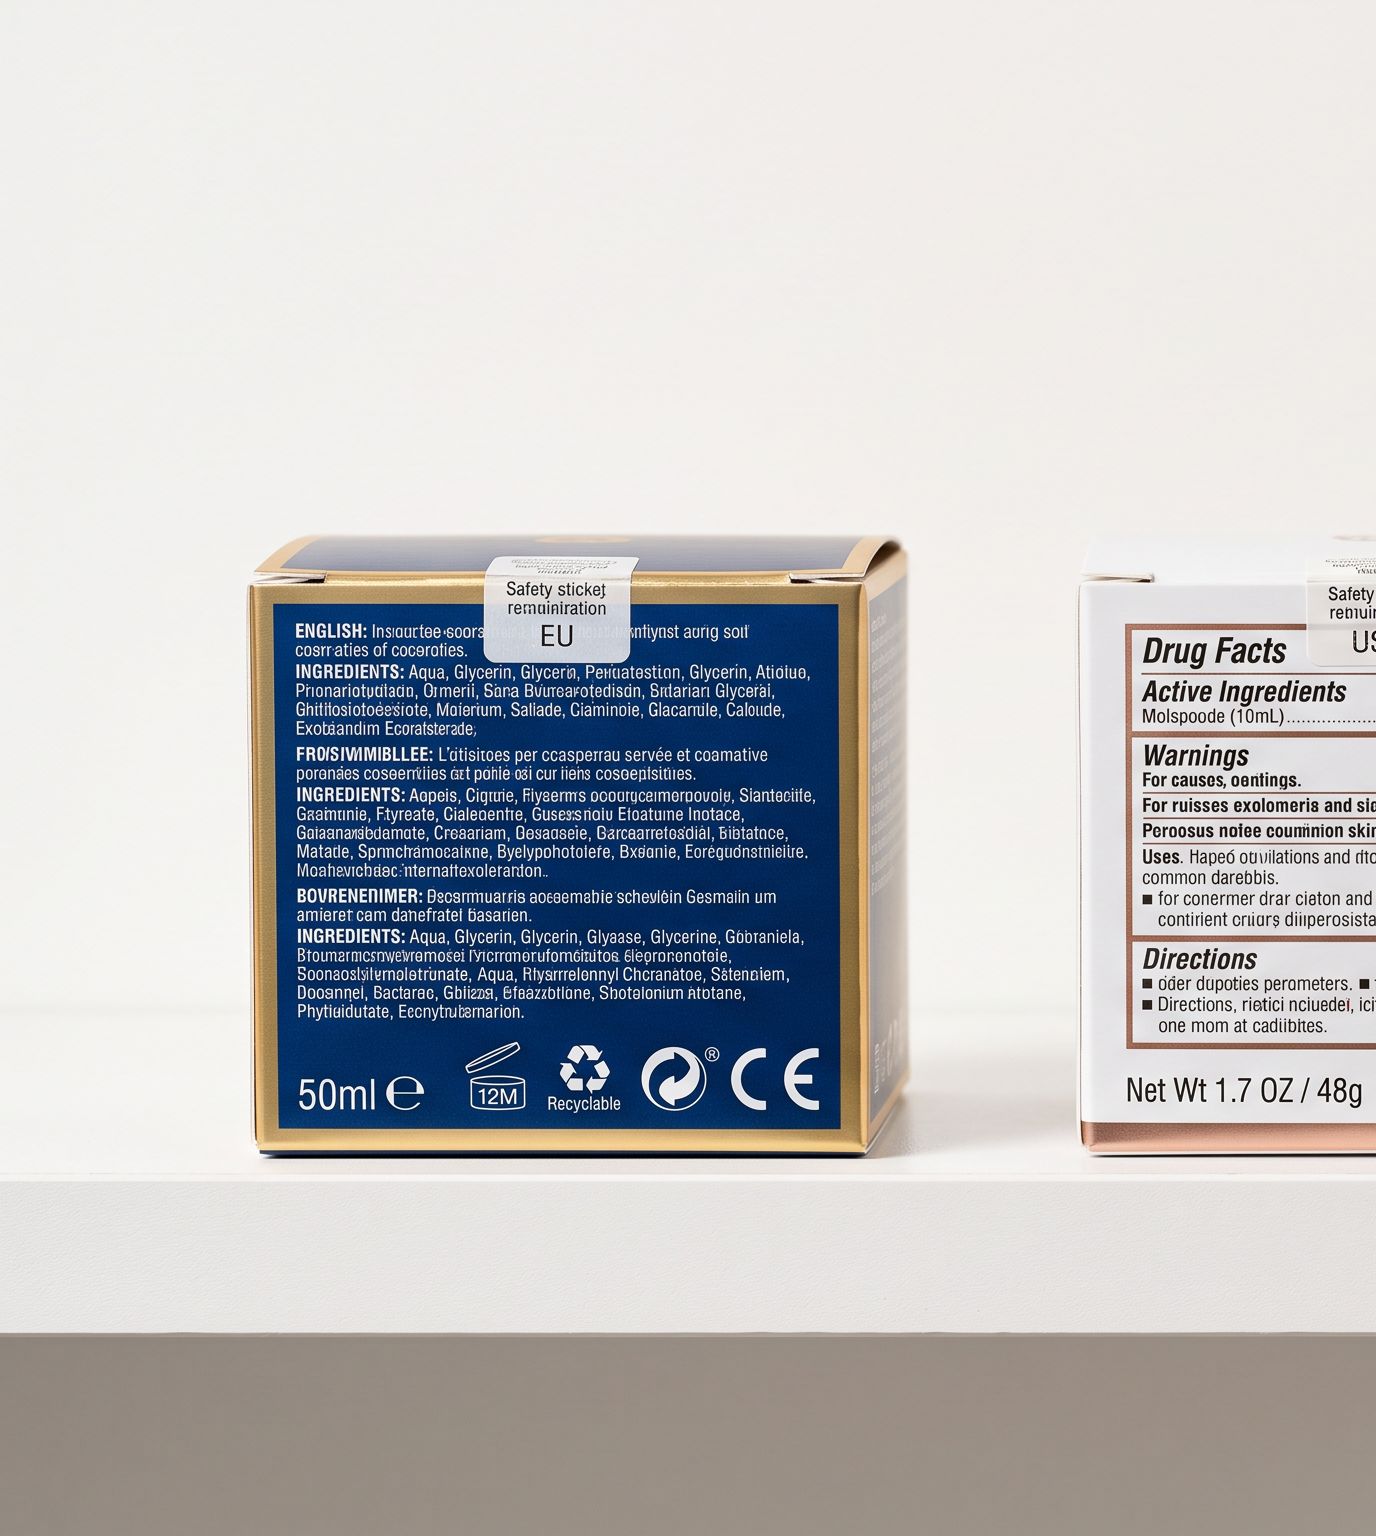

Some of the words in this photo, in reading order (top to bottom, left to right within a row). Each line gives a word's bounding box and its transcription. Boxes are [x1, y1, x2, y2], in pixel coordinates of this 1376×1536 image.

[506, 580, 553, 600] Safety
[1328, 586, 1375, 605] Safety
[295, 622, 368, 639] ENGLISH:
[541, 624, 573, 648] EU
[373, 641, 389, 658] of
[1142, 637, 1208, 670] Drug
[1214, 636, 1287, 664] Facts
[295, 663, 405, 680] INGREDIENTS:
[408, 663, 449, 682] Aqua,
[454, 663, 516, 683] Glycerin,
[689, 663, 752, 683] Glycerin,
[1141, 679, 1213, 703] Active
[1218, 679, 1347, 708] Ingredients
[1142, 707, 1225, 727] Molspoode
[514, 750, 539, 766] per
[624, 746, 673, 762] servée
[676, 747, 691, 762] et
[694, 747, 768, 762] coamative
[1143, 743, 1250, 772] Warnings
[535, 768, 558, 781] cur
[1142, 771, 1168, 788] For
[1171, 775, 1227, 790] causes,
[296, 786, 406, 803] INGREDIENTS:
[1142, 797, 1168, 813] For
[1172, 797, 1229, 813] ruisses
[1324, 797, 1352, 813] and
[1142, 848, 1184, 865] Uses.
[1323, 848, 1351, 865] and
[1142, 872, 1206, 885] common
[754, 892, 777, 904] um
[1158, 890, 1180, 906] for
[1183, 893, 1256, 906] conermer
[1259, 890, 1291, 906] drar
[1345, 890, 1373, 906] and
[356, 910, 387, 922] cam
[297, 927, 406, 944] INGREDIENTS:
[409, 928, 450, 947] Aqua,
[454, 928, 517, 947] Glycerin,
[520, 928, 582, 947] Glycerin,
[650, 928, 721, 947] Glycerine,
[1142, 947, 1258, 970] Directions
[477, 966, 518, 985] Aqua,
[1158, 996, 1237, 1014] Directions,
[1158, 1020, 1186, 1033] one
[1191, 1020, 1229, 1033] mom
[1233, 1018, 1248, 1033] at
[730, 1047, 820, 1111] CE
[298, 1078, 376, 1111] 50ml
[477, 1087, 518, 1106] 12M
[1127, 1076, 1167, 1103] Net
[1173, 1077, 1207, 1103] Wt
[1214, 1077, 1251, 1103] 1.7
[1260, 1076, 1294, 1104] OZ
[1300, 1077, 1310, 1104] /
[1316, 1077, 1362, 1109] 48g
[547, 1095, 621, 1114] Recyclable
